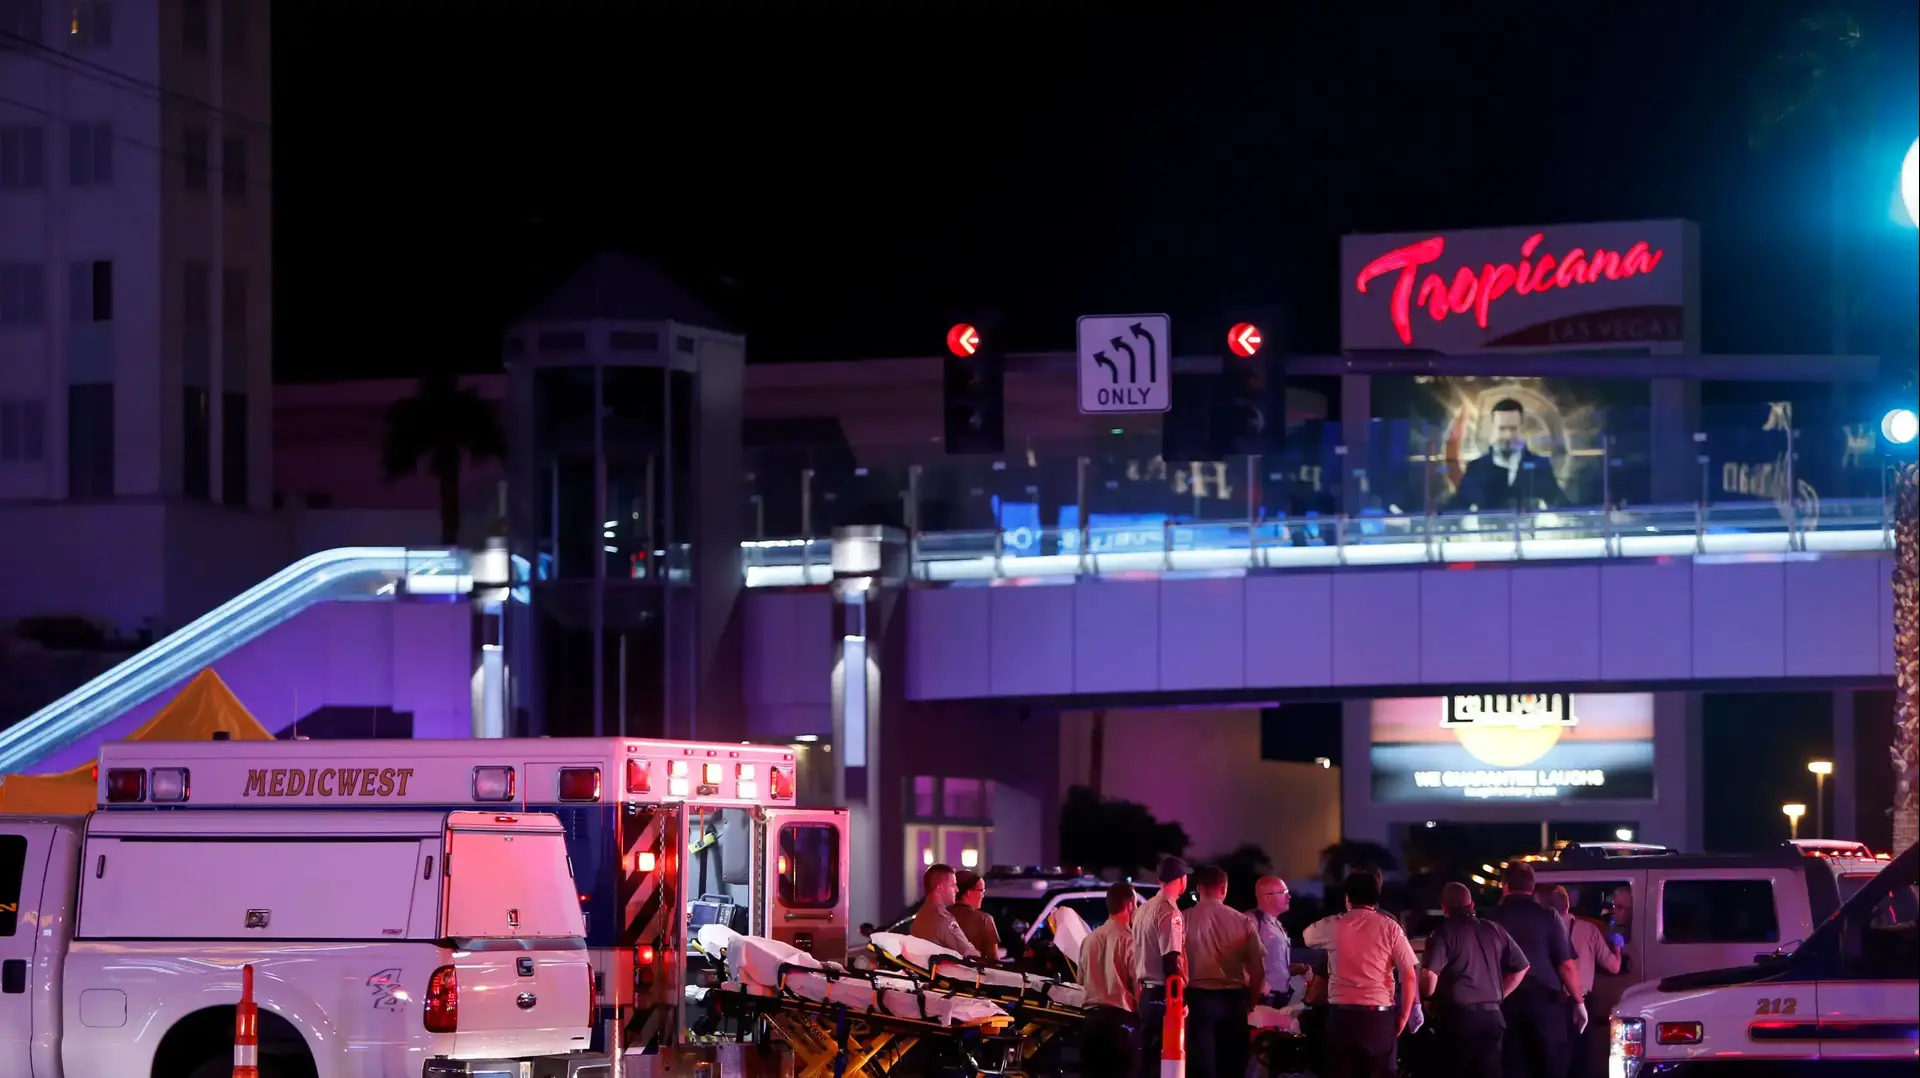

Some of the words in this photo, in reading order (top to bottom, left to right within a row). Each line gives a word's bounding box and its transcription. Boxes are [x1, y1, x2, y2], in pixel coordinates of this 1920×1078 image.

[1357, 232, 1663, 344] Tropicana
[1549, 321, 1590, 343] LAS
[1598, 316, 1678, 340] VEGAS
[1097, 387, 1151, 405] ONLY
[243, 767, 414, 797] MEDICWEST
[1755, 997, 1797, 1015] 212
